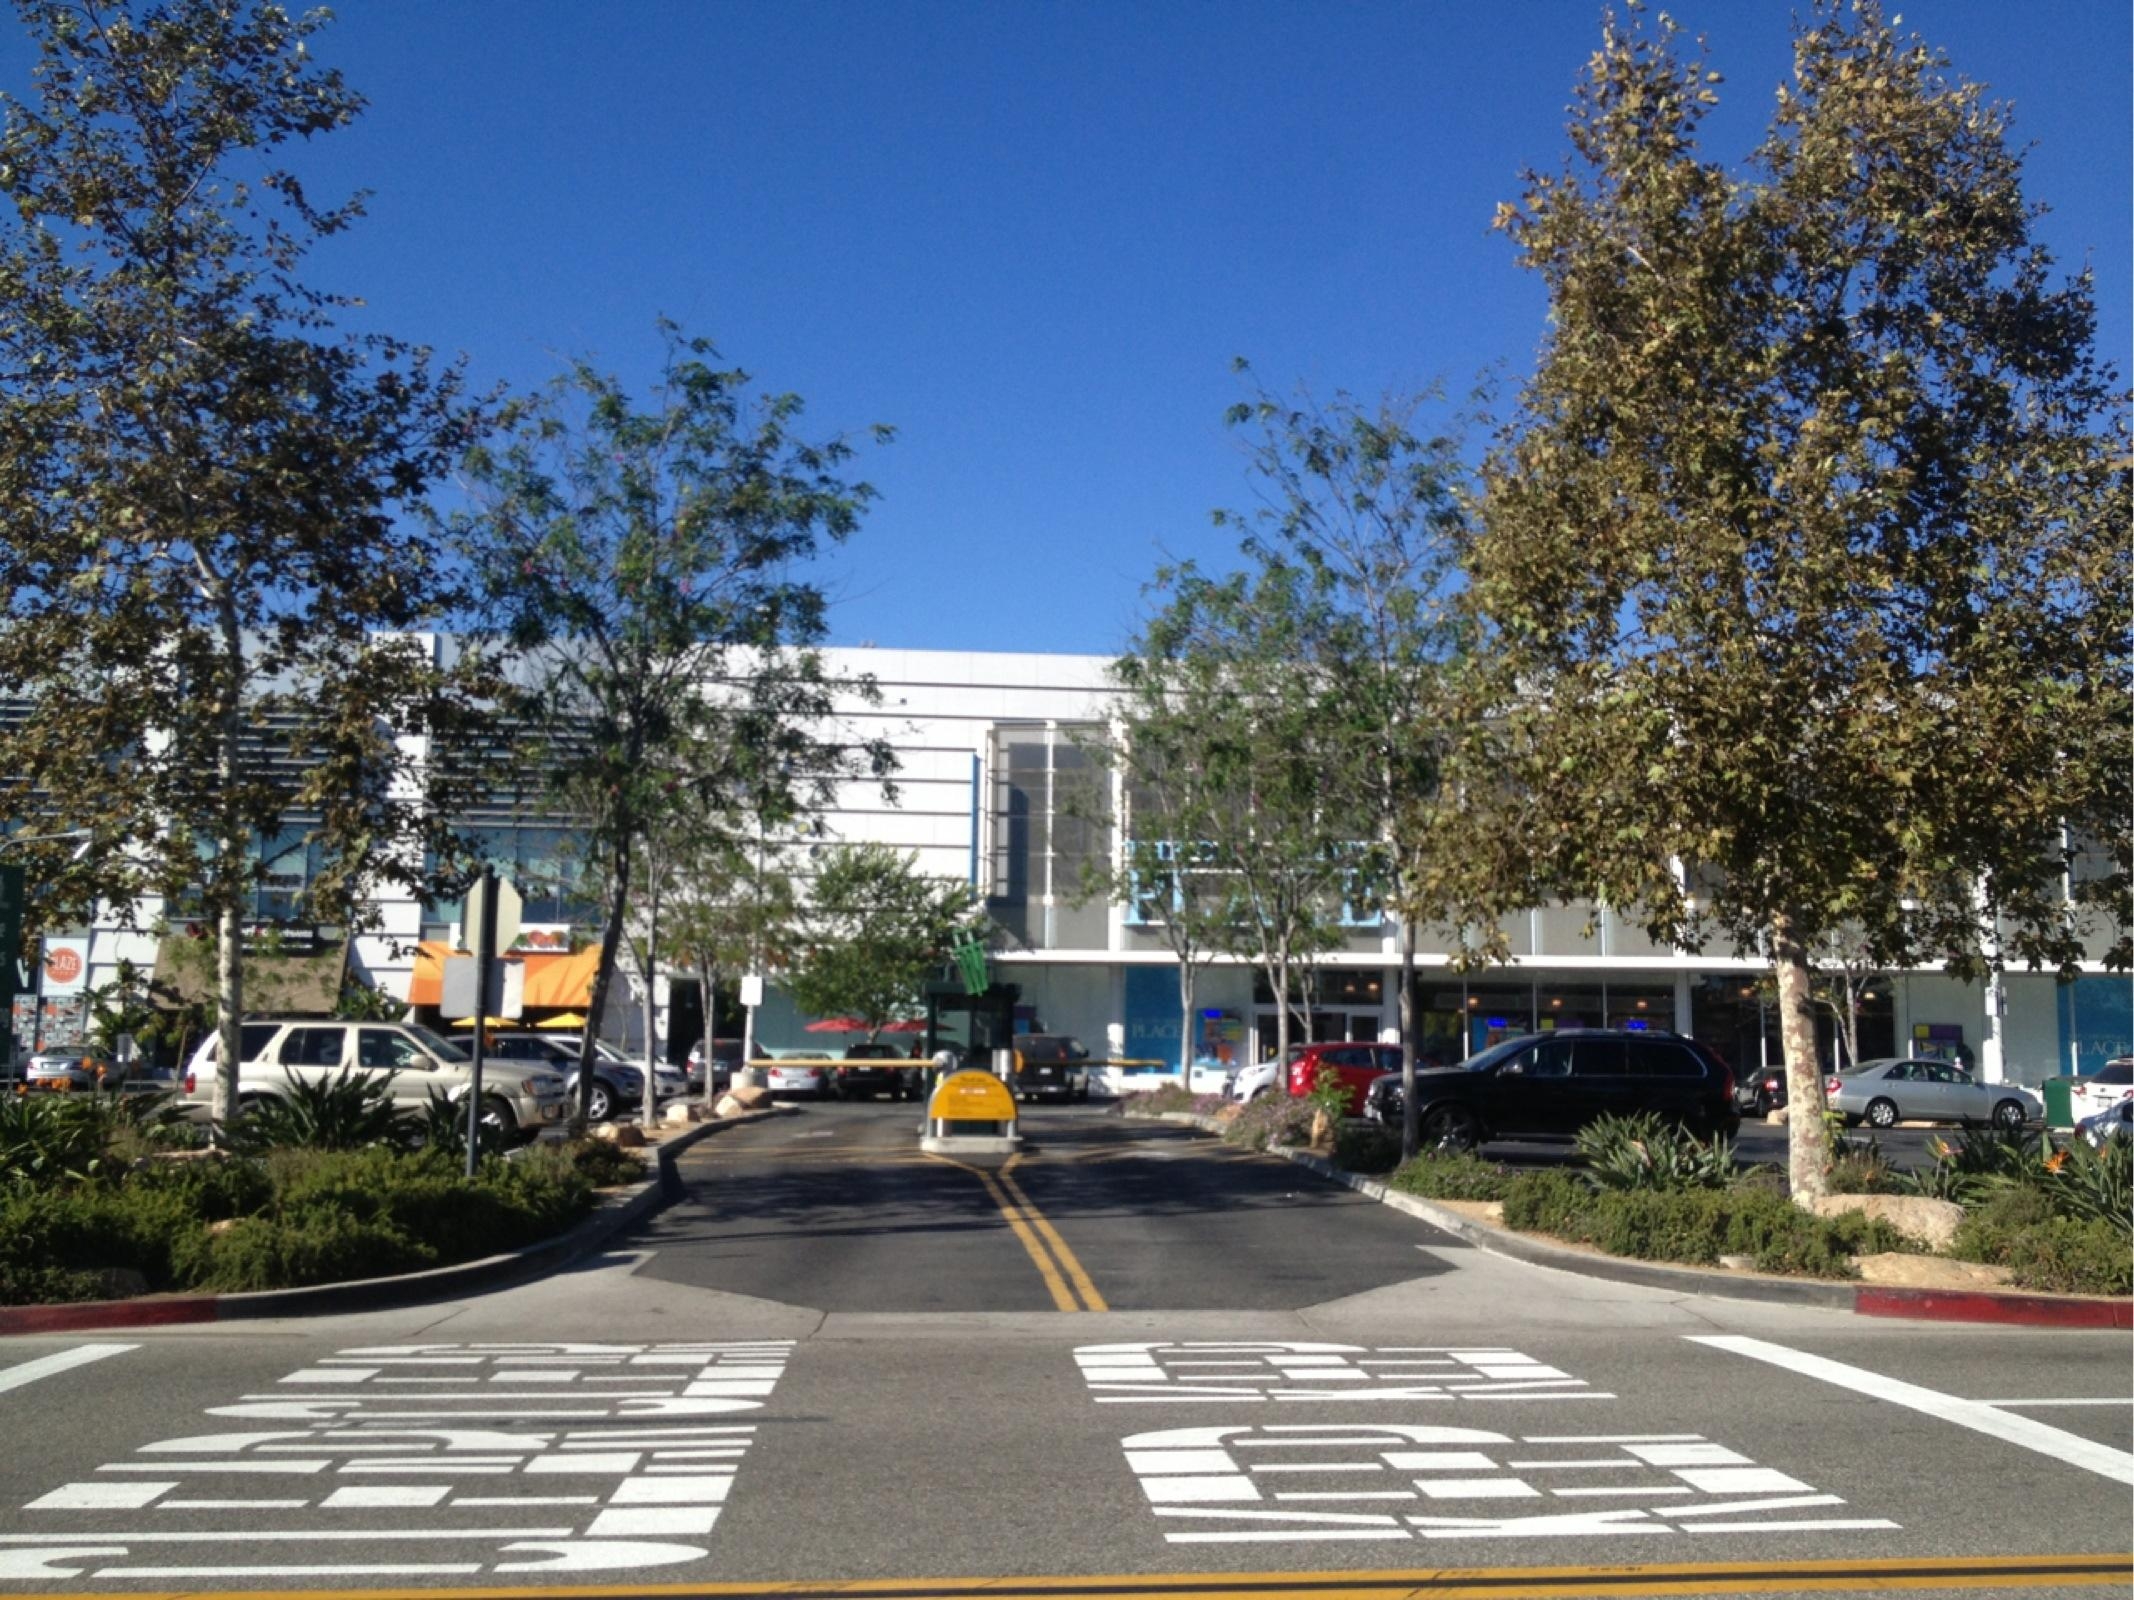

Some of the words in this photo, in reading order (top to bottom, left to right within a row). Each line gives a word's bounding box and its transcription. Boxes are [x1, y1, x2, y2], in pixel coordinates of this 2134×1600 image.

[2069, 1039, 2130, 1056] LACE
[203, 1339, 798, 1418] CLEAR
[1073, 1341, 1618, 1404] KEEP
[0, 1426, 759, 1580] CLEAR
[1121, 1425, 1903, 1544] KEEP
